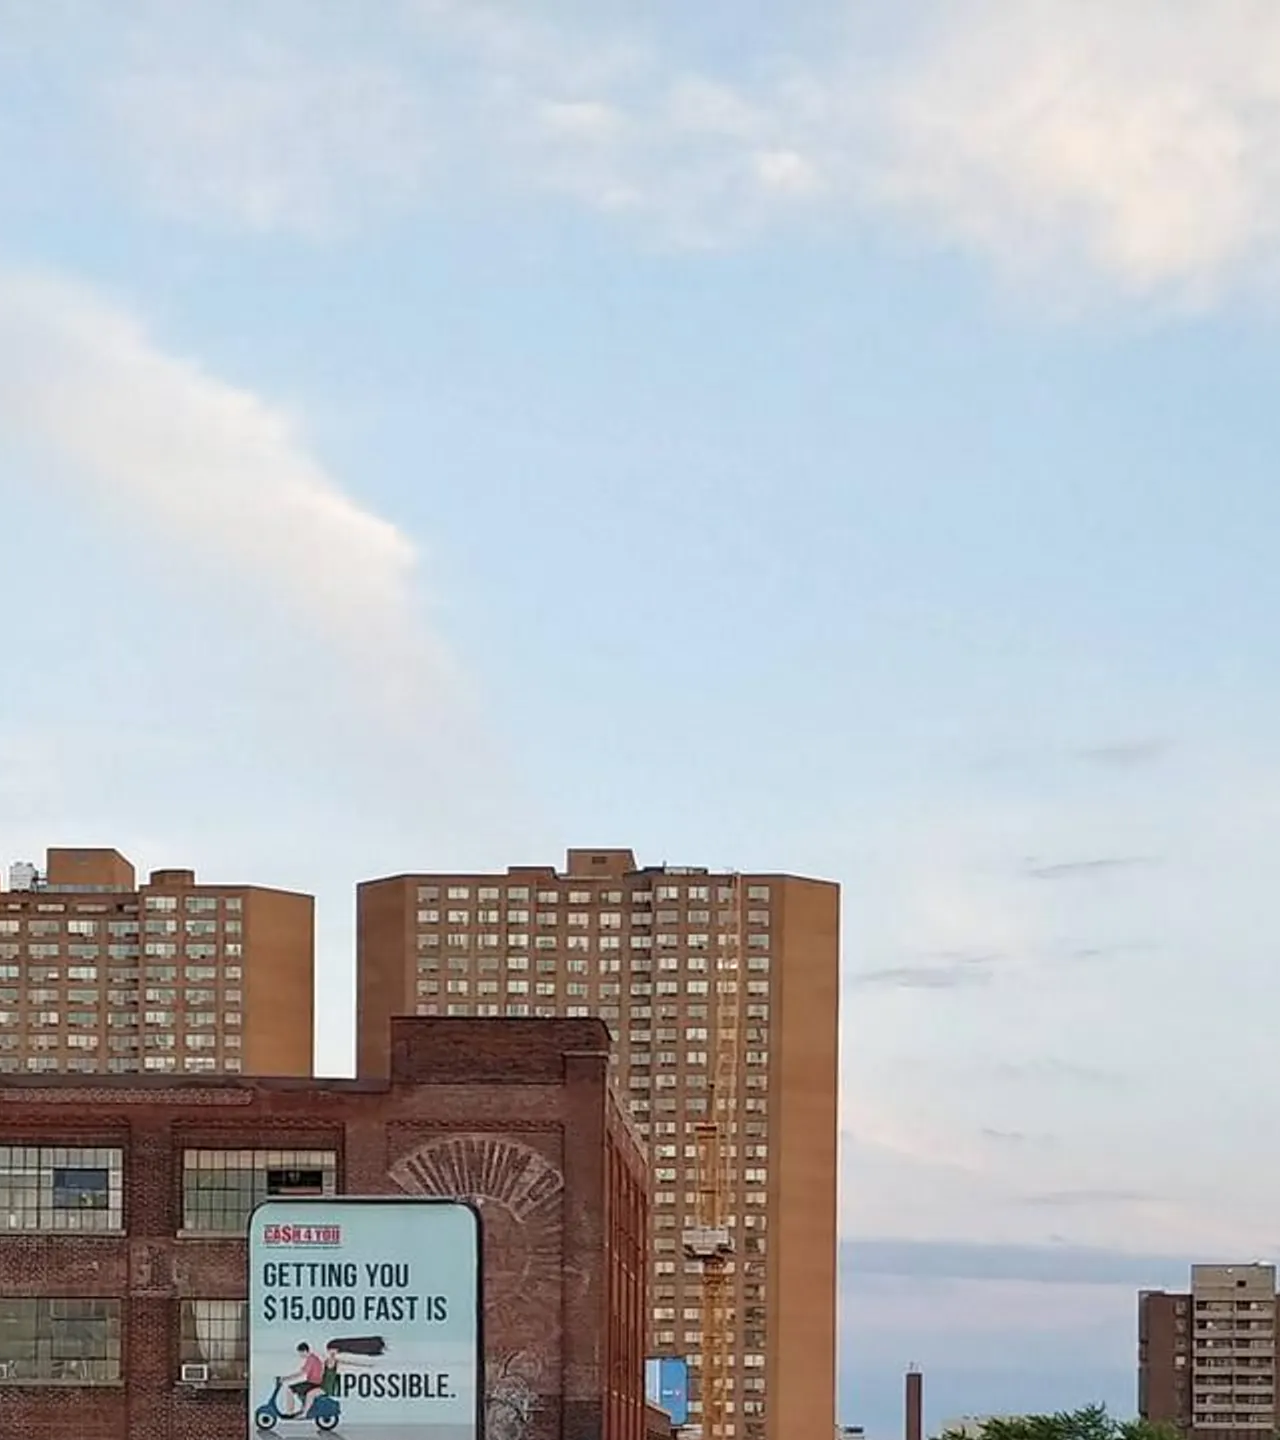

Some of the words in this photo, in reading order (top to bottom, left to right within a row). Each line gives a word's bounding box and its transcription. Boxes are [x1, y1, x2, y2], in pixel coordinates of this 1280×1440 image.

[264, 1225, 301, 1243] CASH
[263, 1263, 357, 1288] GETTING
[365, 1263, 409, 1287] YOU
[263, 1294, 355, 1322] $15,000
[363, 1296, 419, 1322] FAST
[427, 1296, 448, 1321] IS
